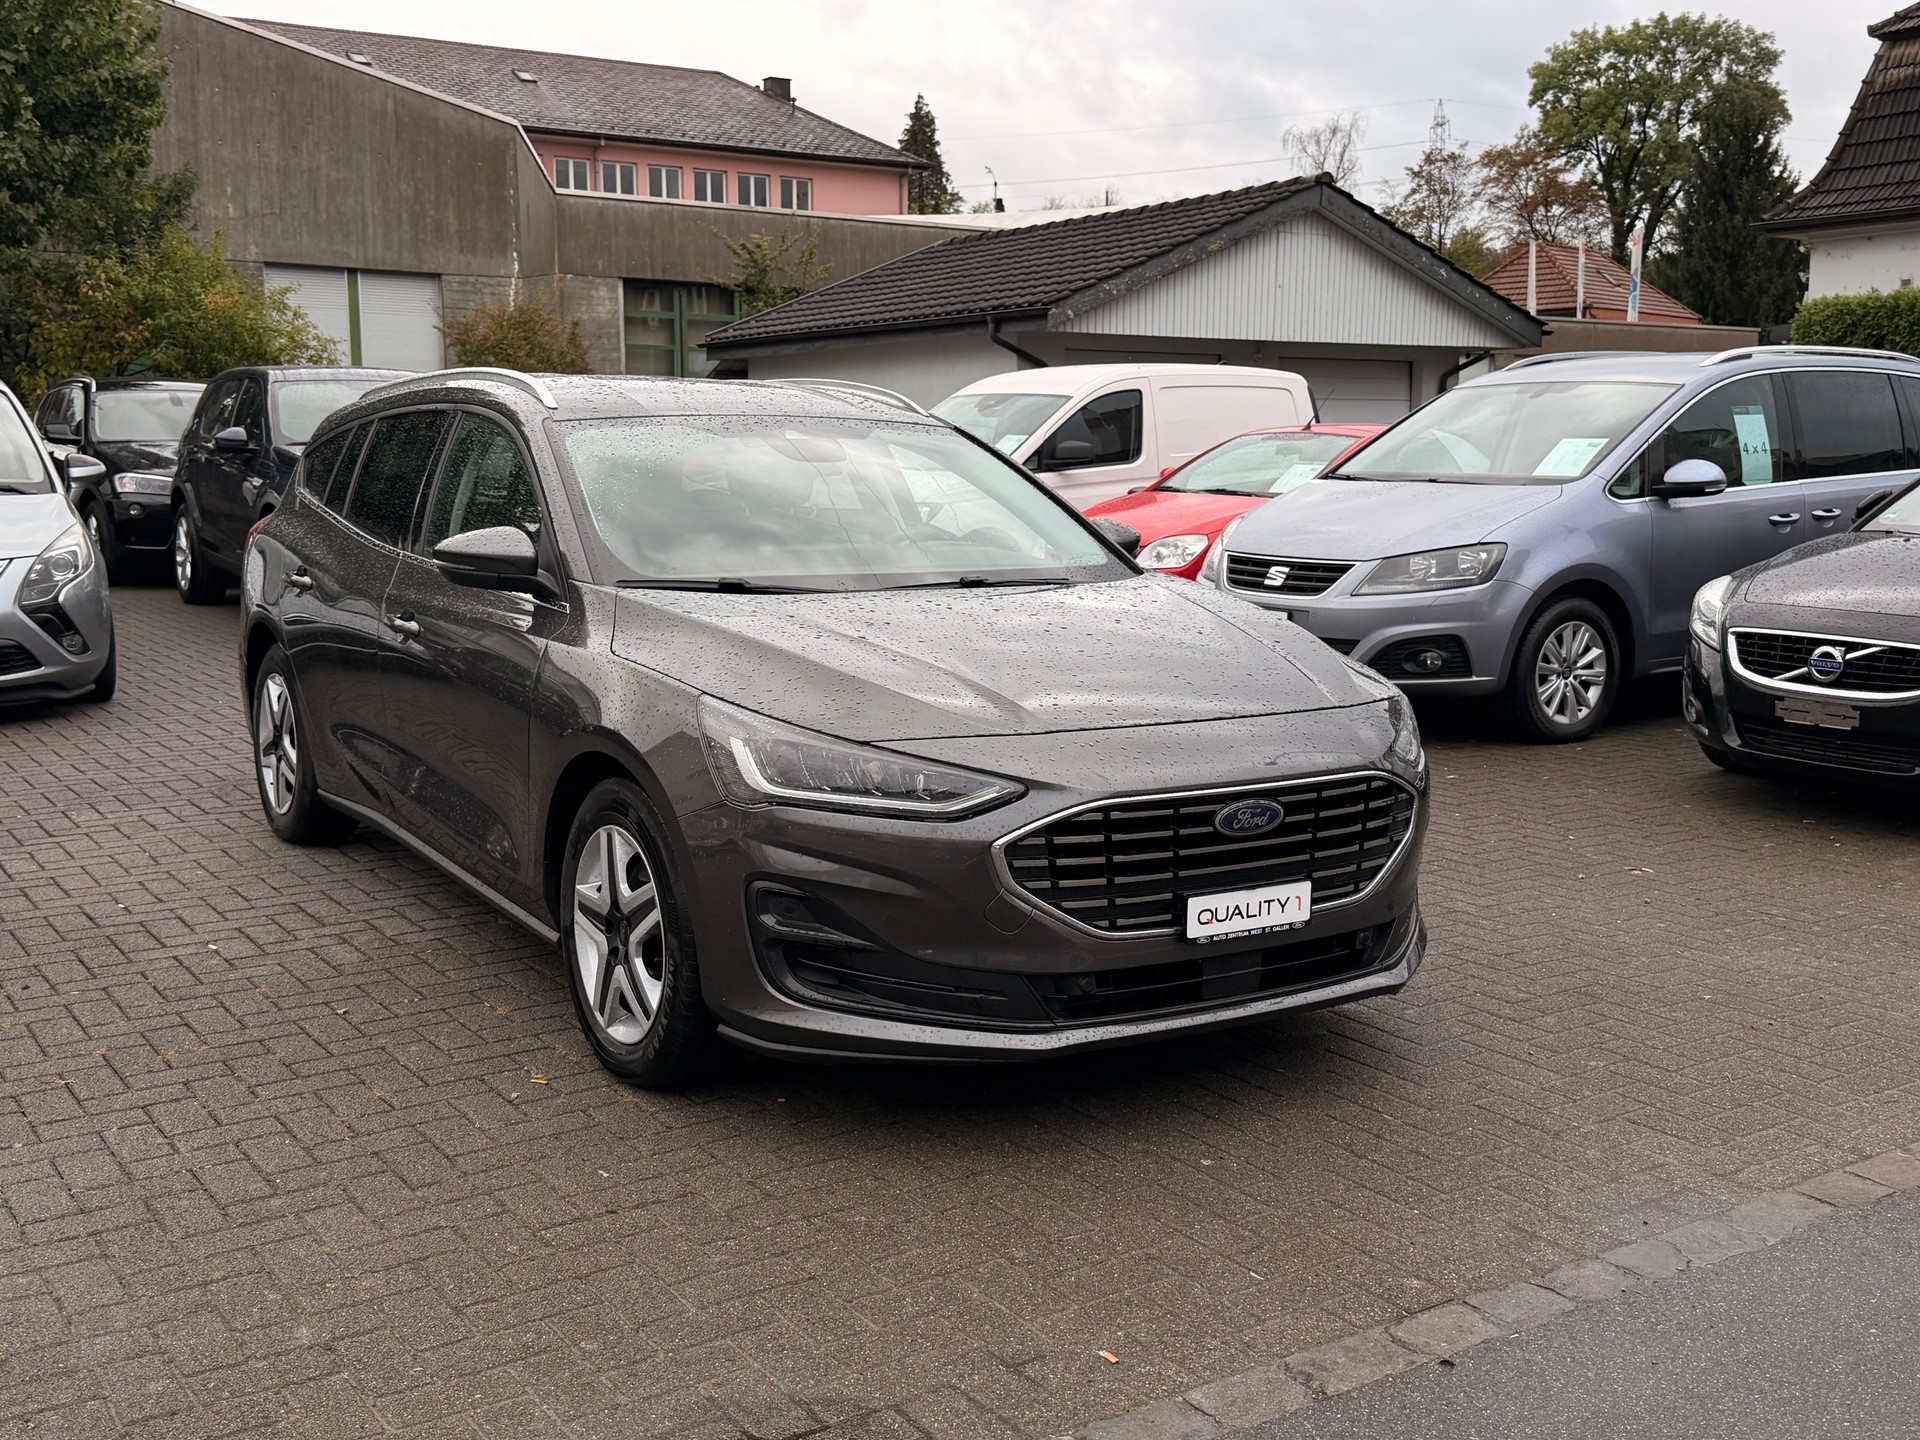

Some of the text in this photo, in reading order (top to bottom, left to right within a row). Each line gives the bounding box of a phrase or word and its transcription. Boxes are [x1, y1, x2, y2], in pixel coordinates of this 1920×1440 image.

[1810, 660, 1840, 670] VOLVO
[1233, 808, 1271, 829] Ford
[1198, 895, 1302, 925] QUALITY 1
[1213, 932, 1226, 941] AUTO
[1227, 930, 1249, 939] ZENTRUM
[1250, 927, 1262, 935] WEST
[1273, 924, 1290, 932] GALLEN
